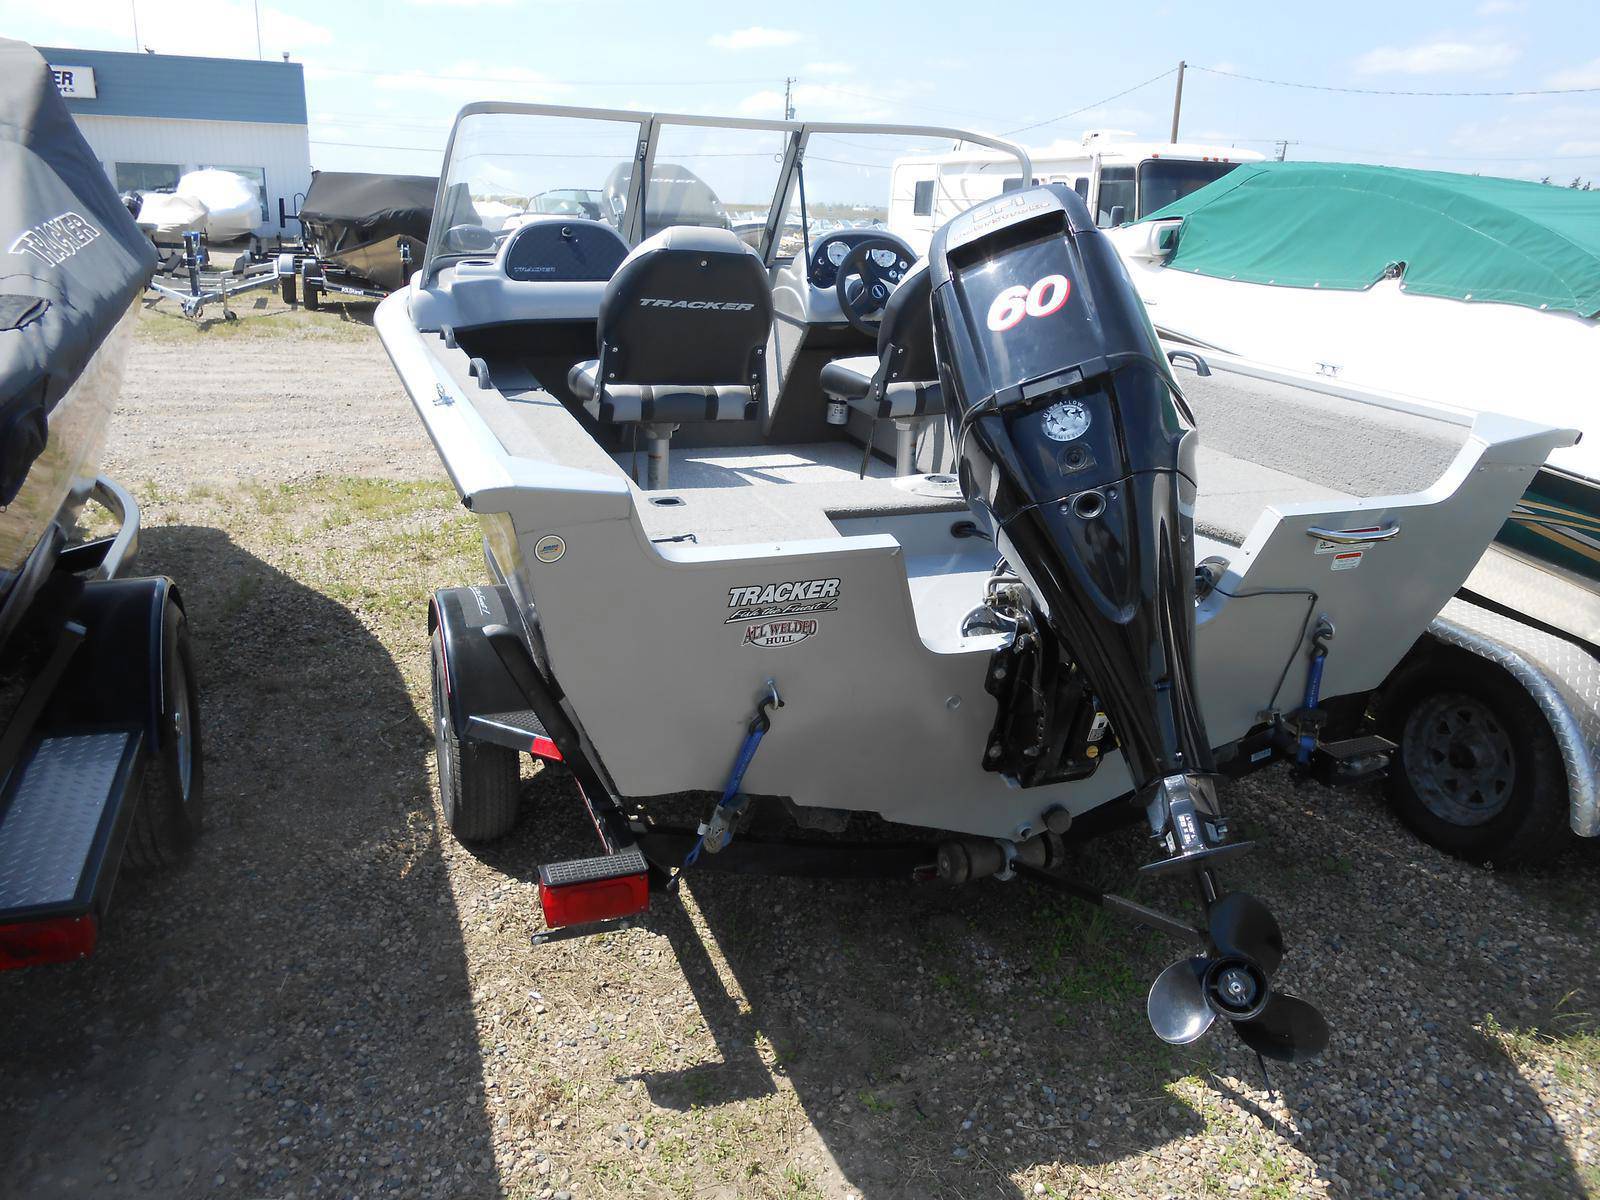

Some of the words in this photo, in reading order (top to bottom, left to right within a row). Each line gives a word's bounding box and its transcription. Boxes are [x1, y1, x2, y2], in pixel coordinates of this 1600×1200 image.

[53, 71, 74, 86] ER
[8, 211, 100, 268] TRACKER
[640, 298, 755, 311] TRACKER
[987, 274, 1071, 332] 60
[728, 578, 840, 607] TRACKER
[743, 624, 768, 645] ALL
[769, 620, 818, 636] WELDED
[766, 635, 794, 645] HULL
